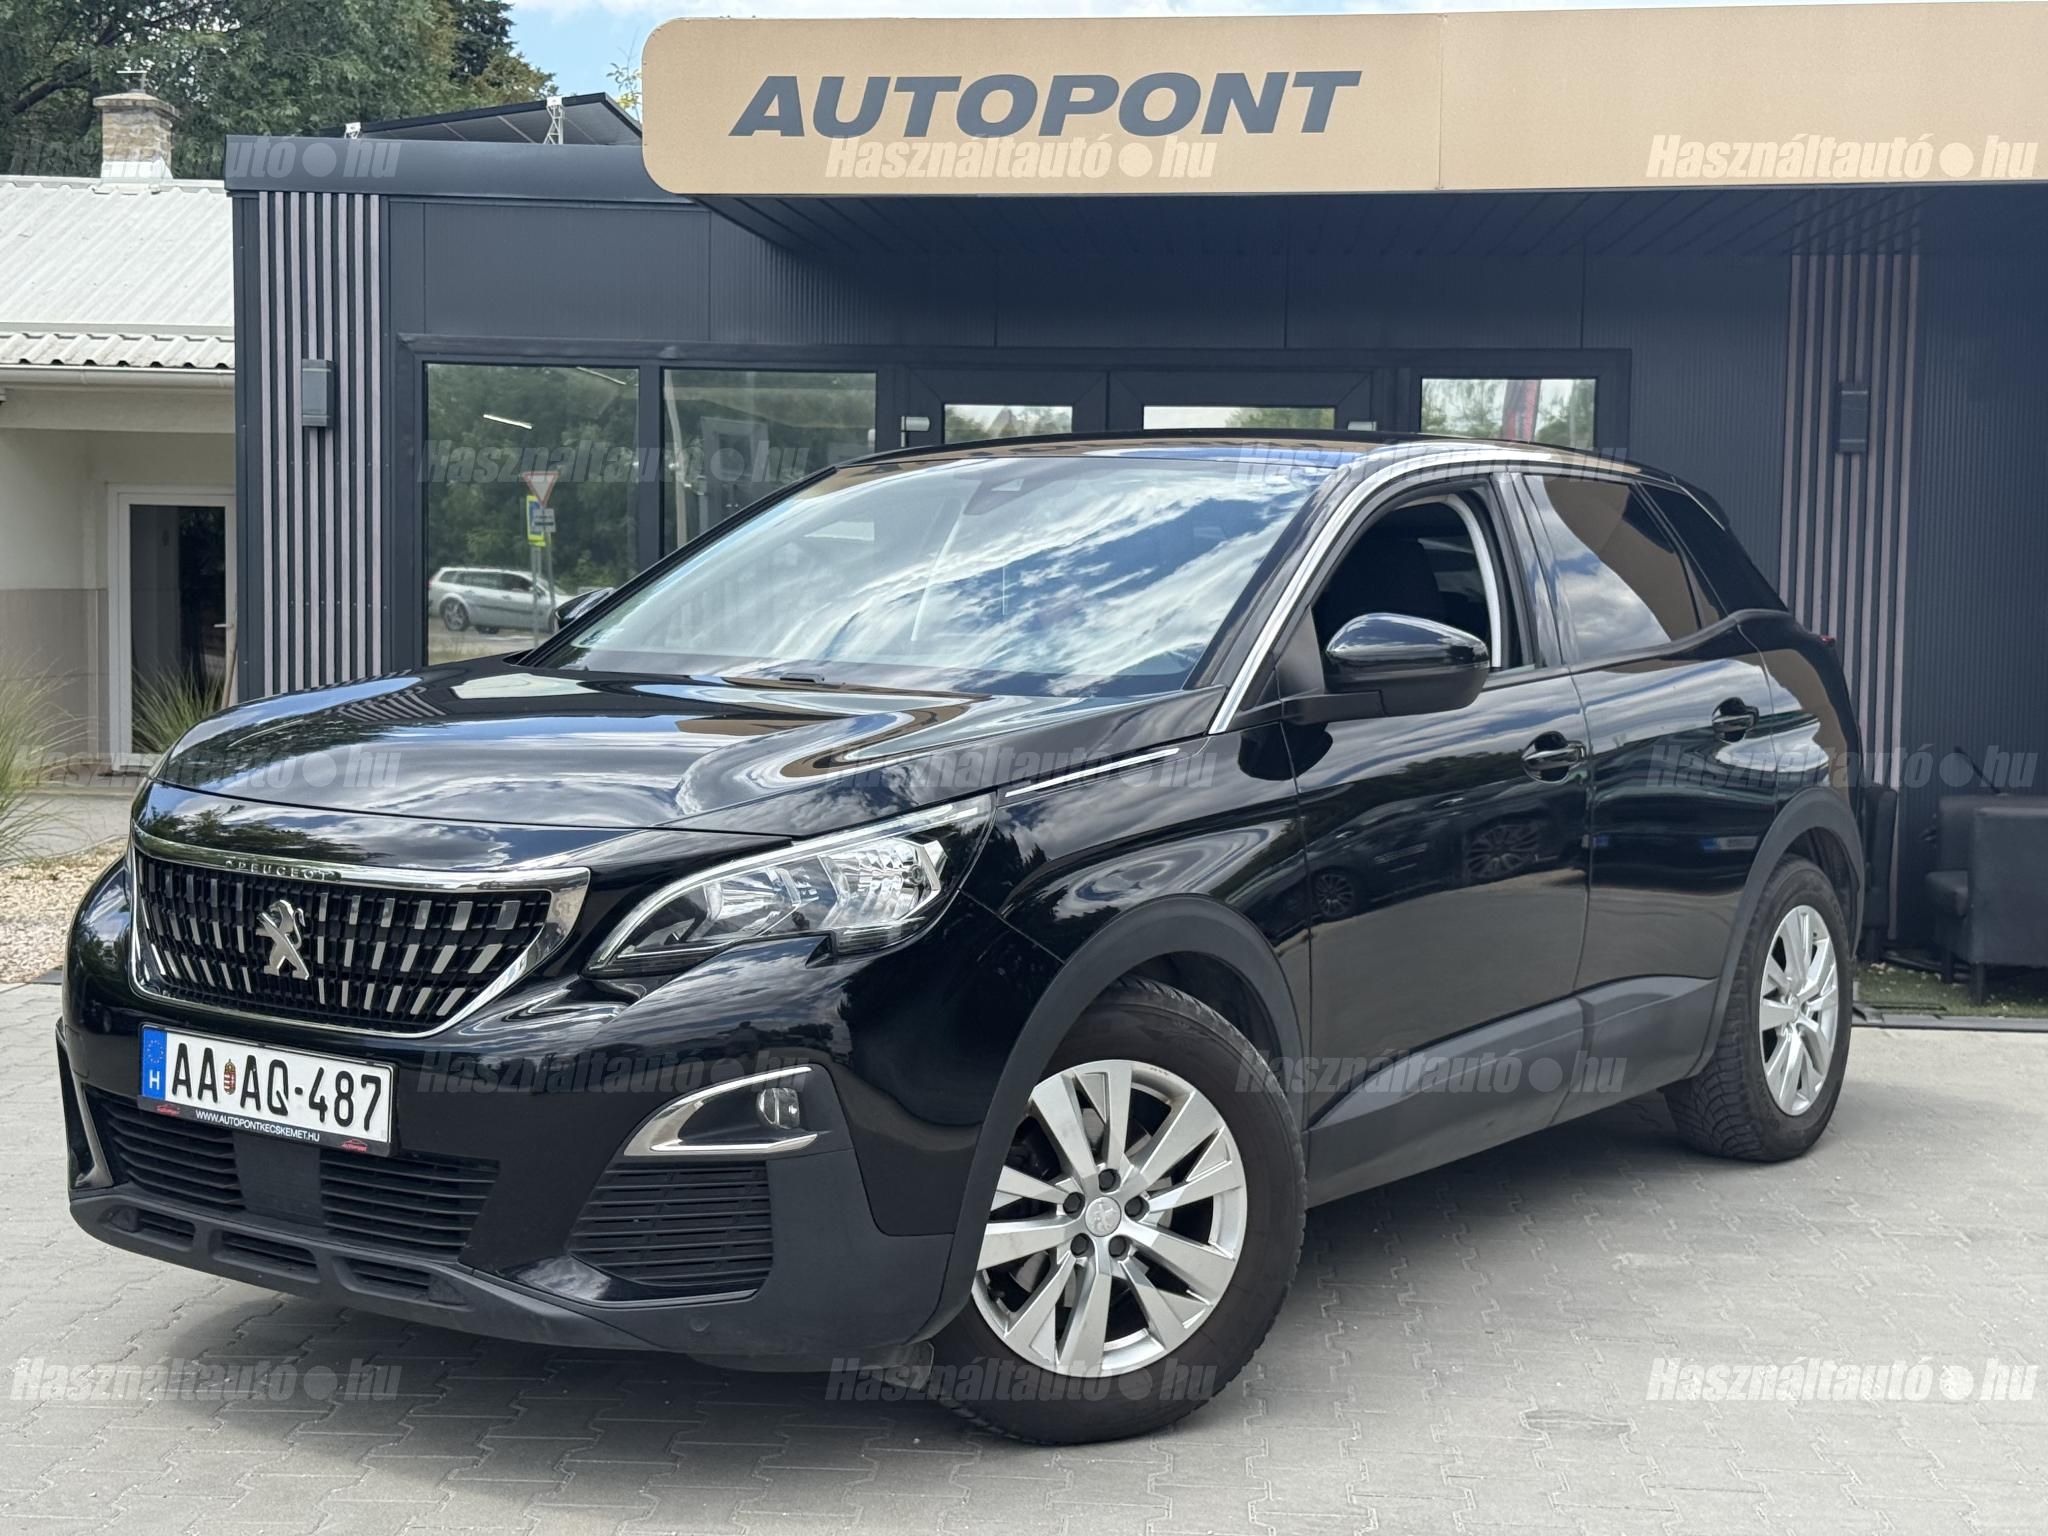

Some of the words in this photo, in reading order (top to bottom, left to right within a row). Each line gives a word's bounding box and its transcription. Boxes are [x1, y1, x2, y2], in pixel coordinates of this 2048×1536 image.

[728, 70, 1363, 138] AUTOPONT
[237, 860, 329, 882] PEUGEOT
[148, 1068, 161, 1092] H
[171, 1042, 218, 1104] AA
[239, 1053, 382, 1133] AQ-487
[195, 1108, 320, 1143] WWW.AUTOPONTKECSKEMET.HU
